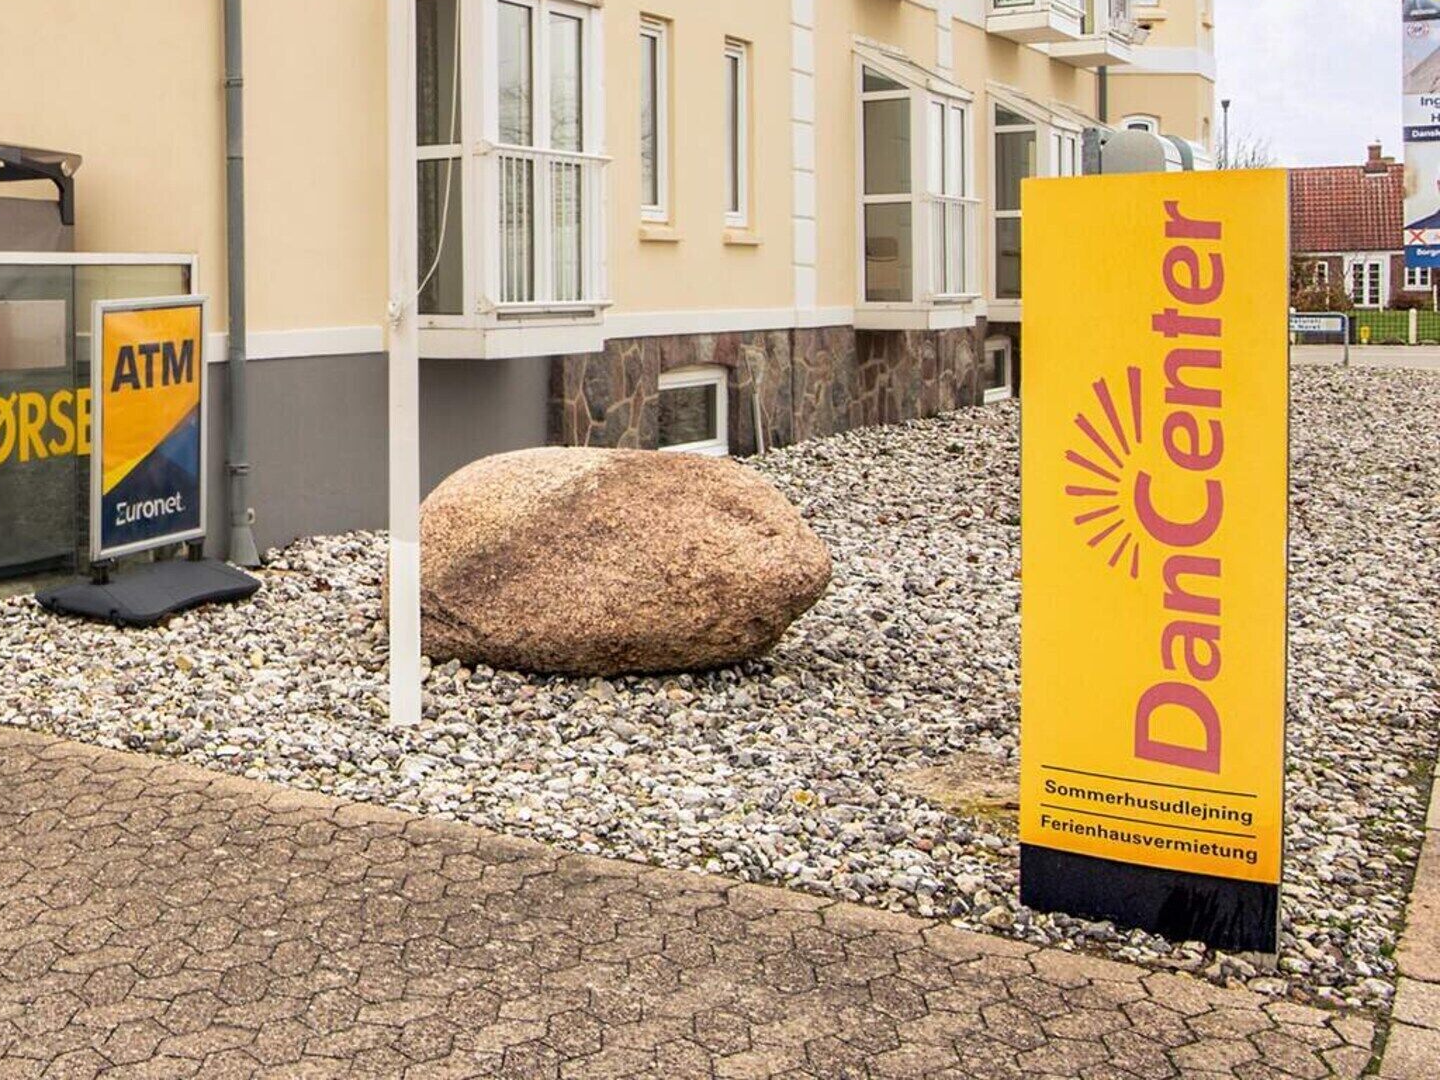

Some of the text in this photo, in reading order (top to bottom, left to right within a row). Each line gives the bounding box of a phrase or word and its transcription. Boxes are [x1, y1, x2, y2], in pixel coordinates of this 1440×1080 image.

[111, 339, 194, 392] ATM
[115, 491, 184, 526] Euronet
[1134, 200, 1224, 775] DanCenter
[1044, 779, 1253, 825] Sommerhusudlejning
[1040, 814, 1258, 865] Ferienhausvermietung
